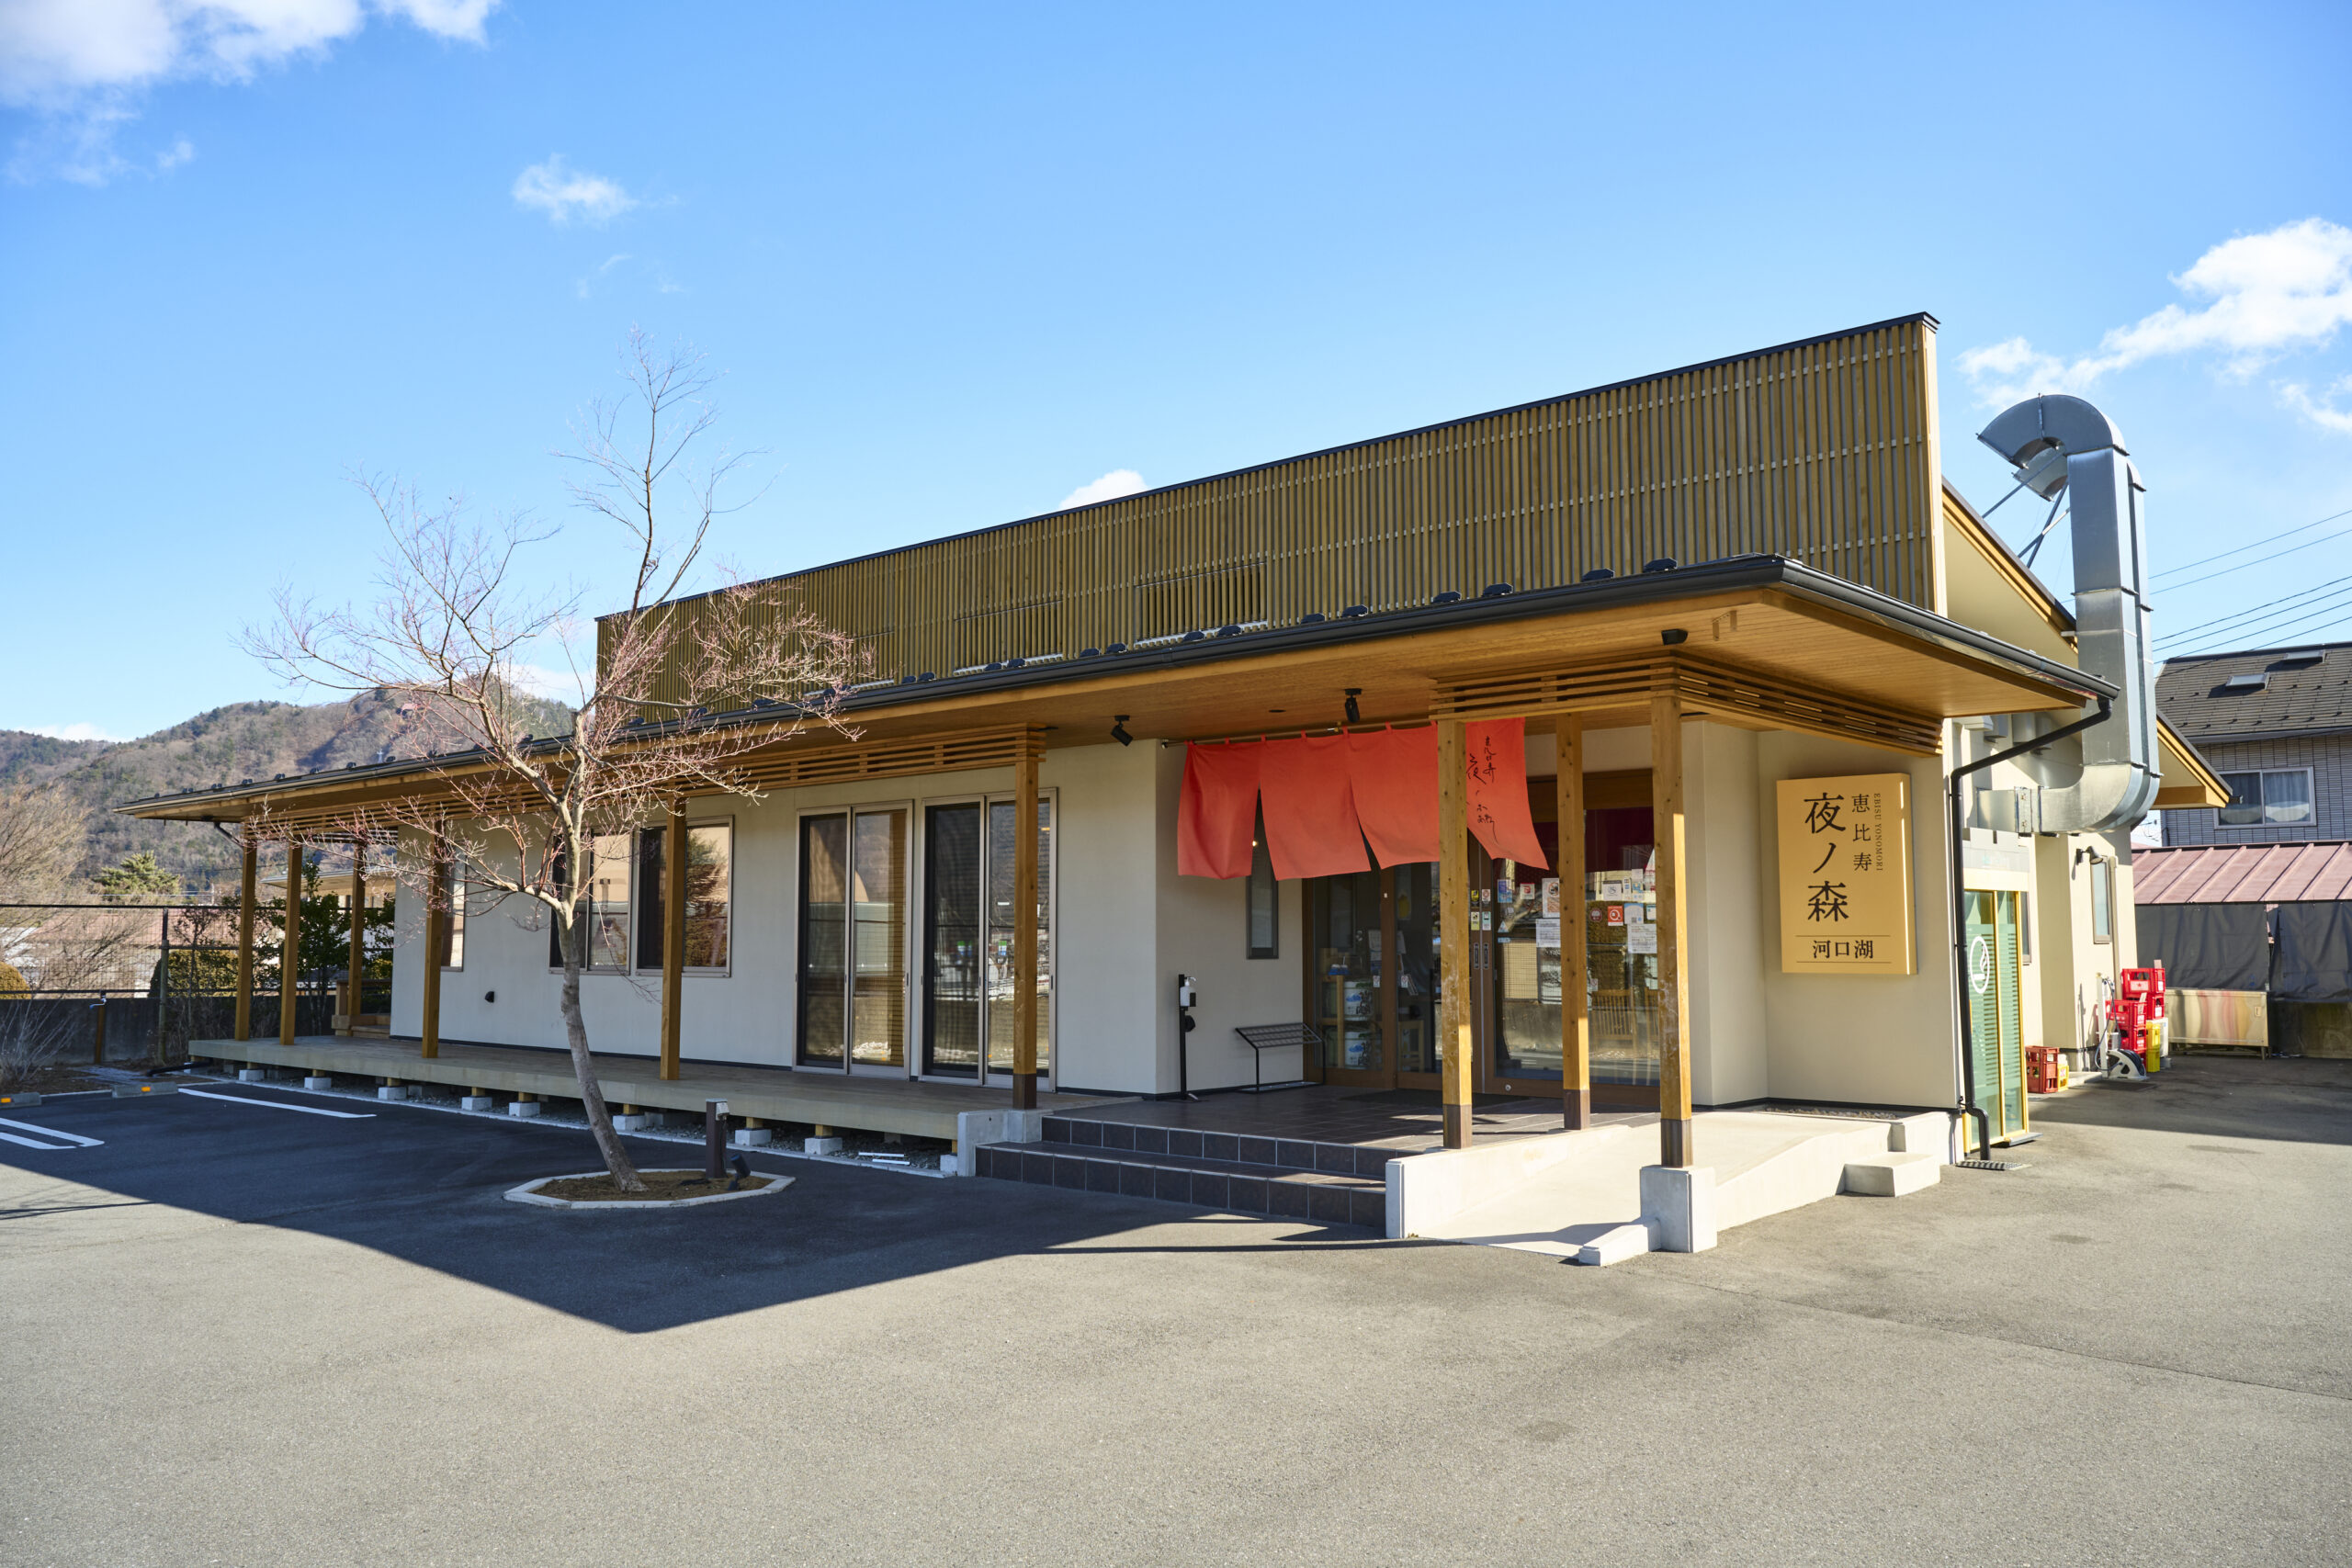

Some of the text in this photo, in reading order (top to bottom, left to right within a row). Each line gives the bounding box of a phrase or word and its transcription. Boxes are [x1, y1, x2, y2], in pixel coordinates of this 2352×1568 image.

[1804, 792, 1849, 922] 夜ノ森
[1851, 793, 1872, 872] 恵比寿
[1874, 823, 1883, 871] YONOMORI
[1812, 939, 1873, 959] 河口湖
